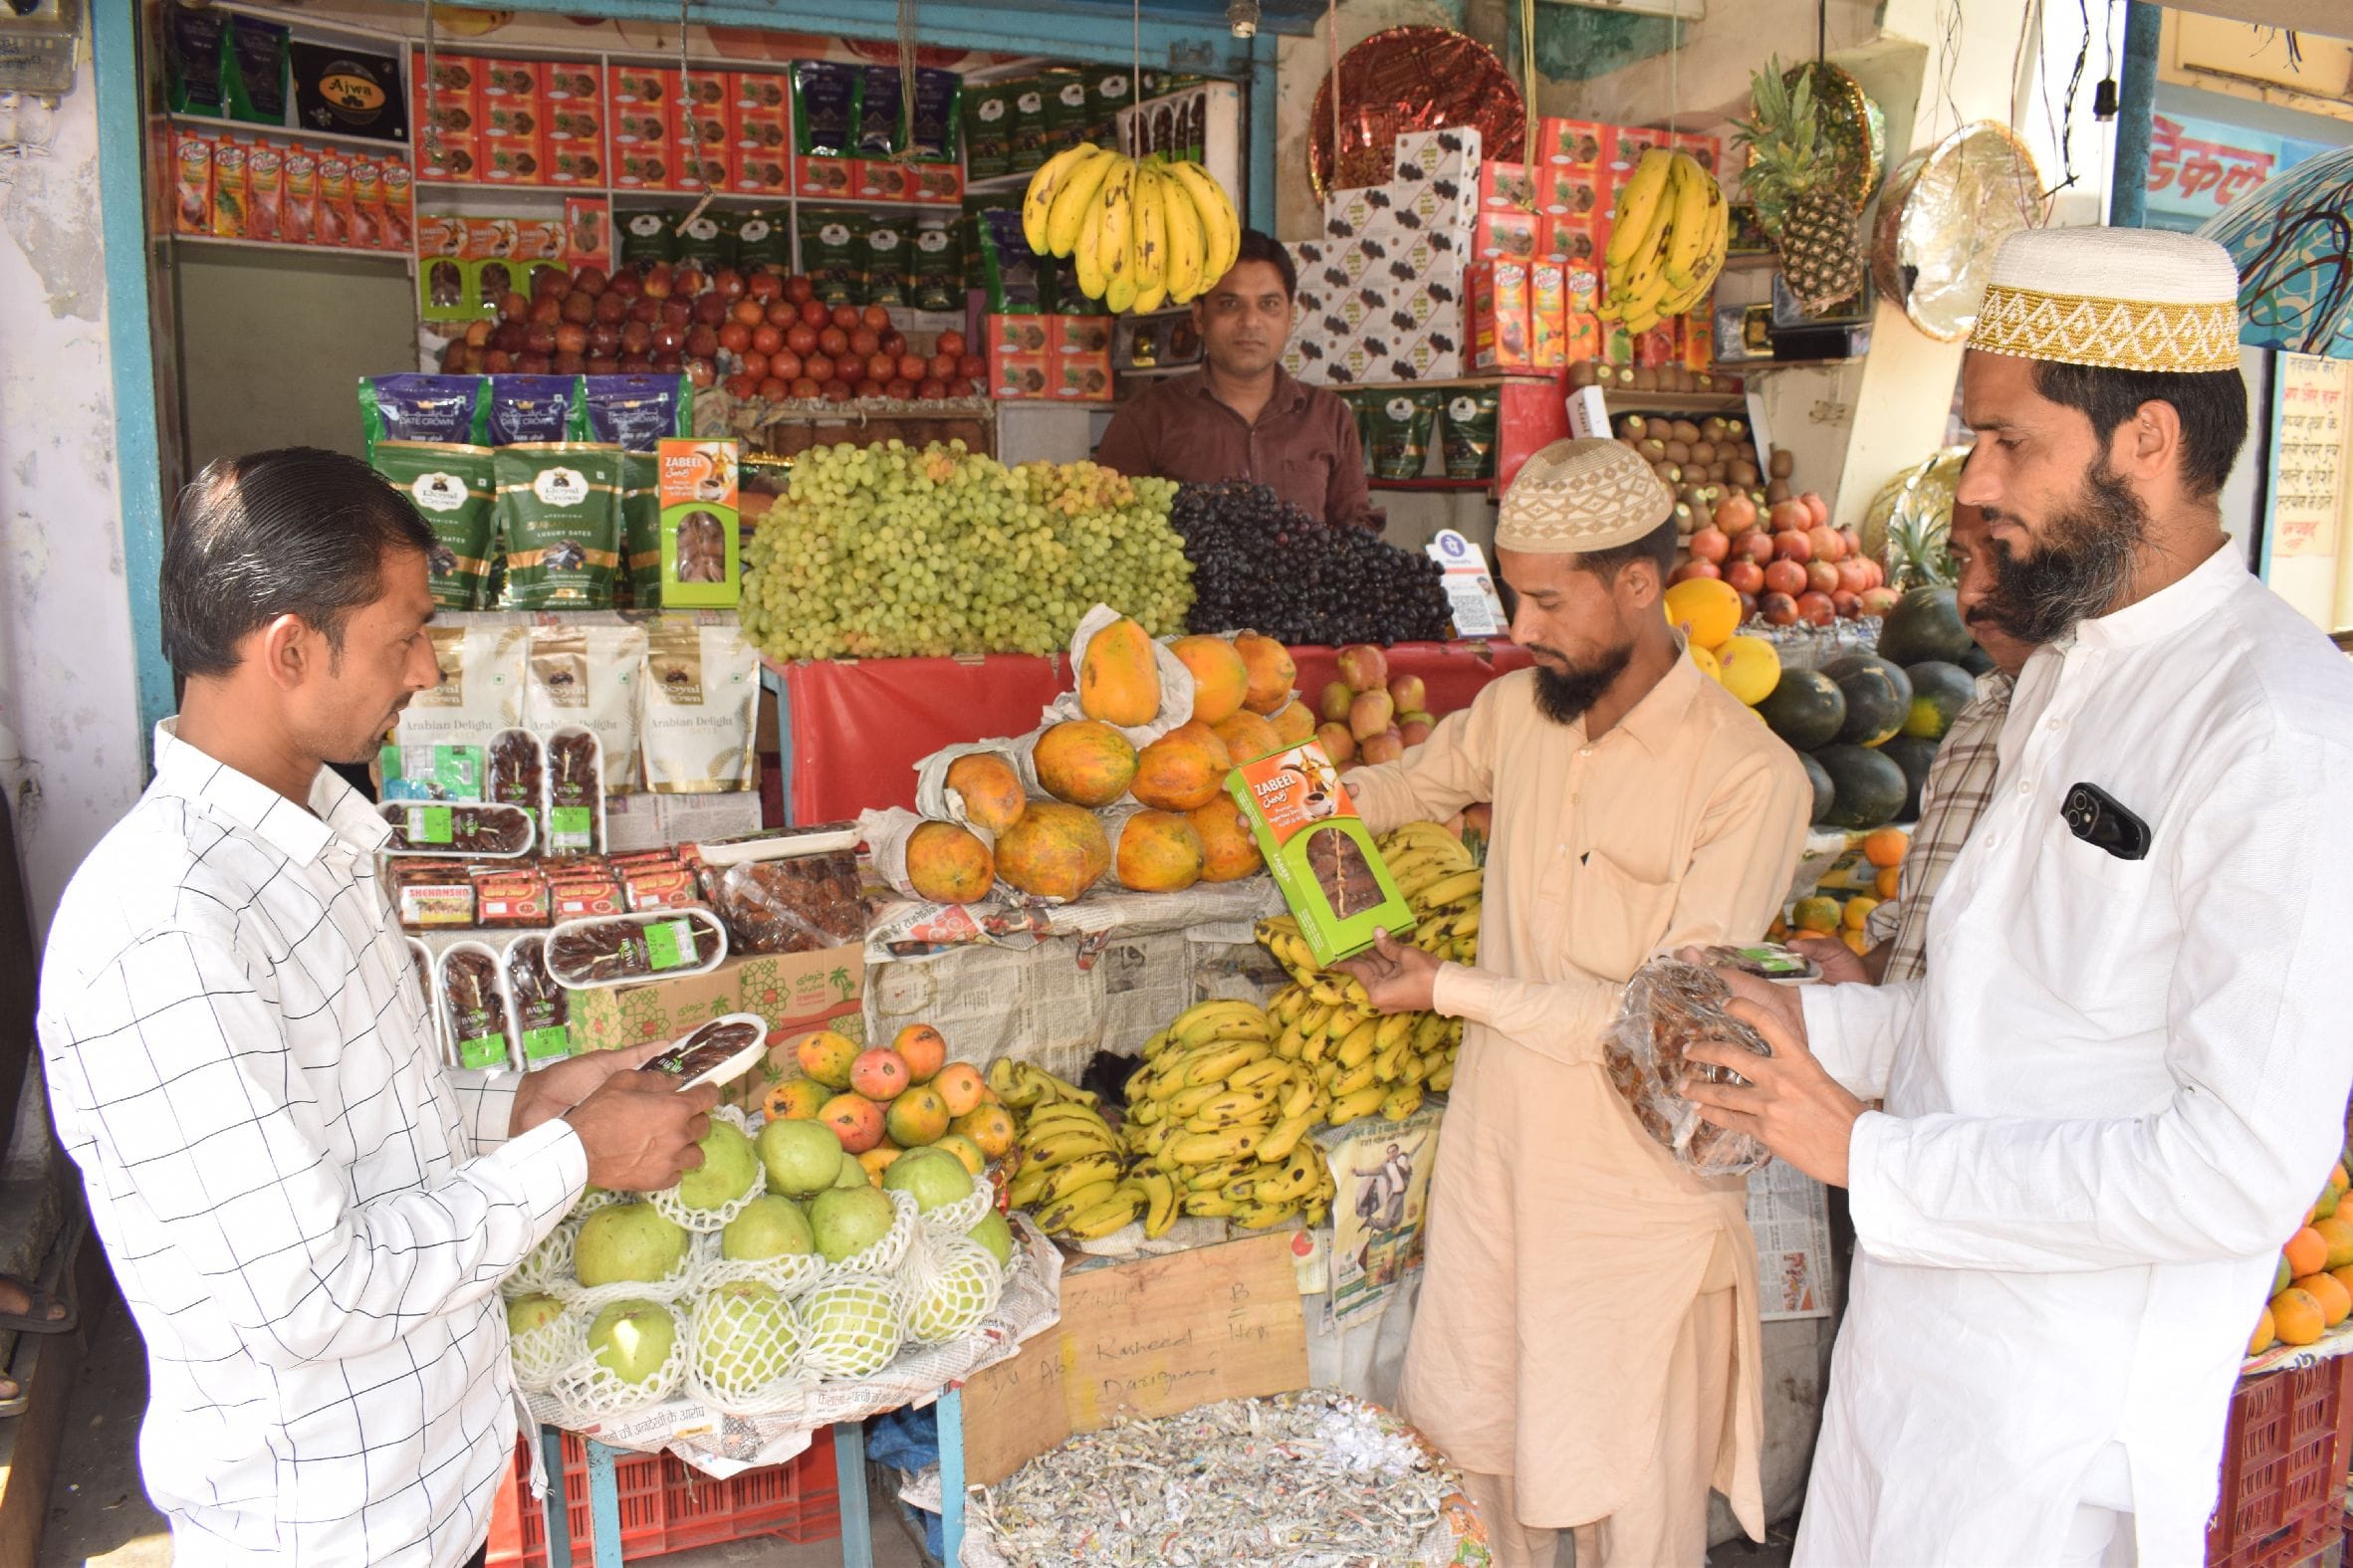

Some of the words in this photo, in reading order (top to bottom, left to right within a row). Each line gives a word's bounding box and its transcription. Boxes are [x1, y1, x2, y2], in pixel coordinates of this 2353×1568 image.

[329, 79, 371, 96] Ajwa
[406, 720, 451, 731] Arabian
[453, 719, 493, 732] Delight
[652, 717, 693, 728] Arabian
[696, 715, 733, 727] Delight
[1254, 774, 1296, 795] ZABEEL
